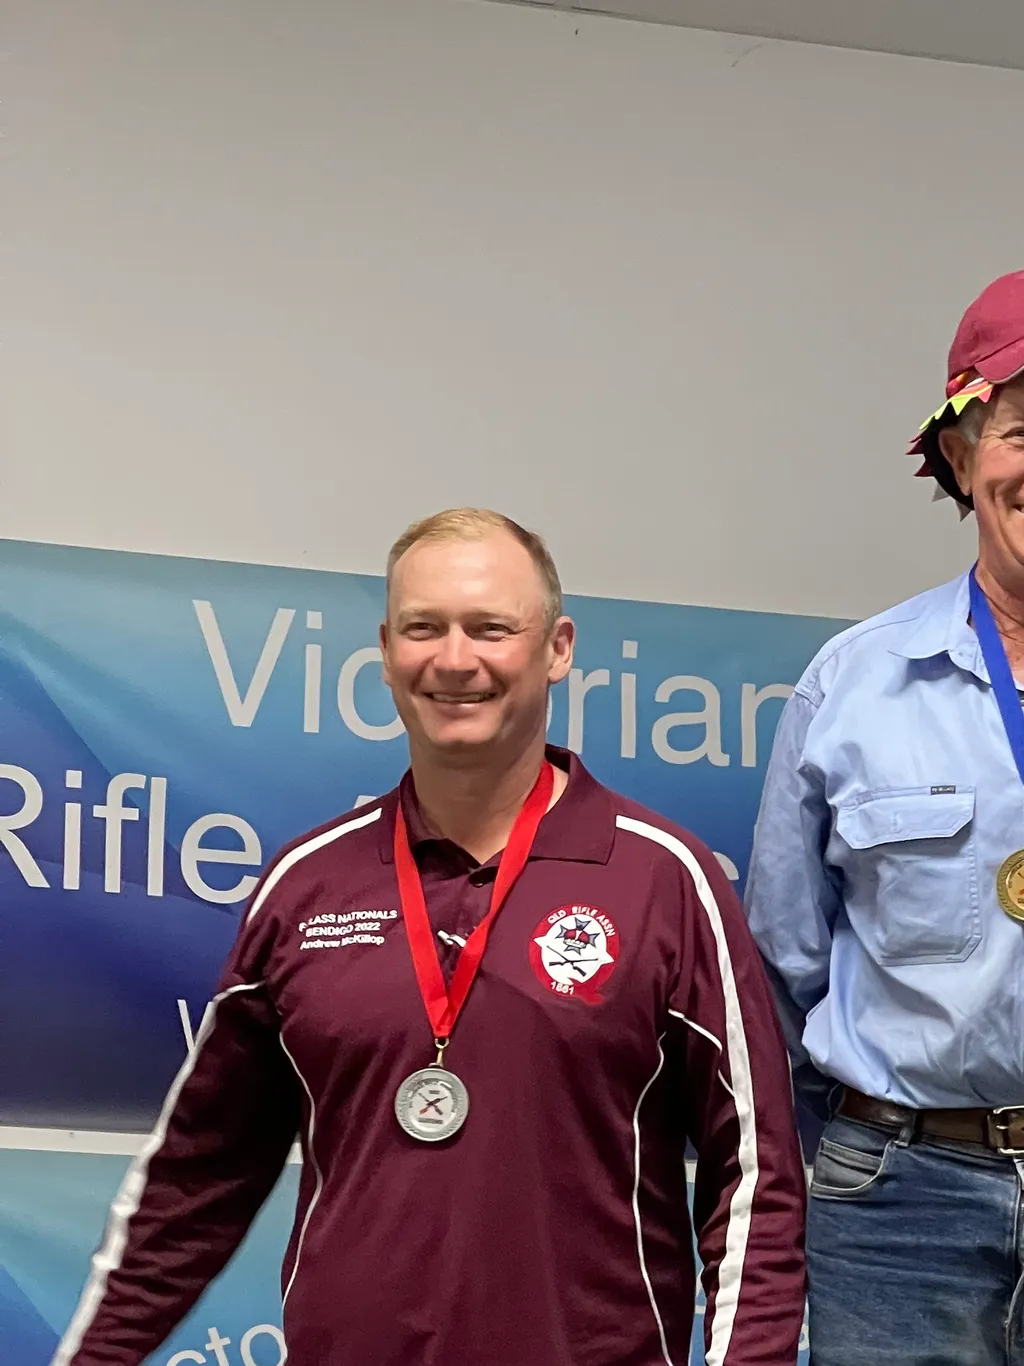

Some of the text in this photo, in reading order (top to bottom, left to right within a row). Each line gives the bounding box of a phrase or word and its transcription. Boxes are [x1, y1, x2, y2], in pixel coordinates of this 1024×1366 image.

[192, 599, 796, 769] Vicrian
[0, 763, 263, 904] Rifle
[305, 921, 381, 938] BENDIGO 2022
[308, 913, 336, 926] LASS
[337, 909, 398, 924] NATIONALS
